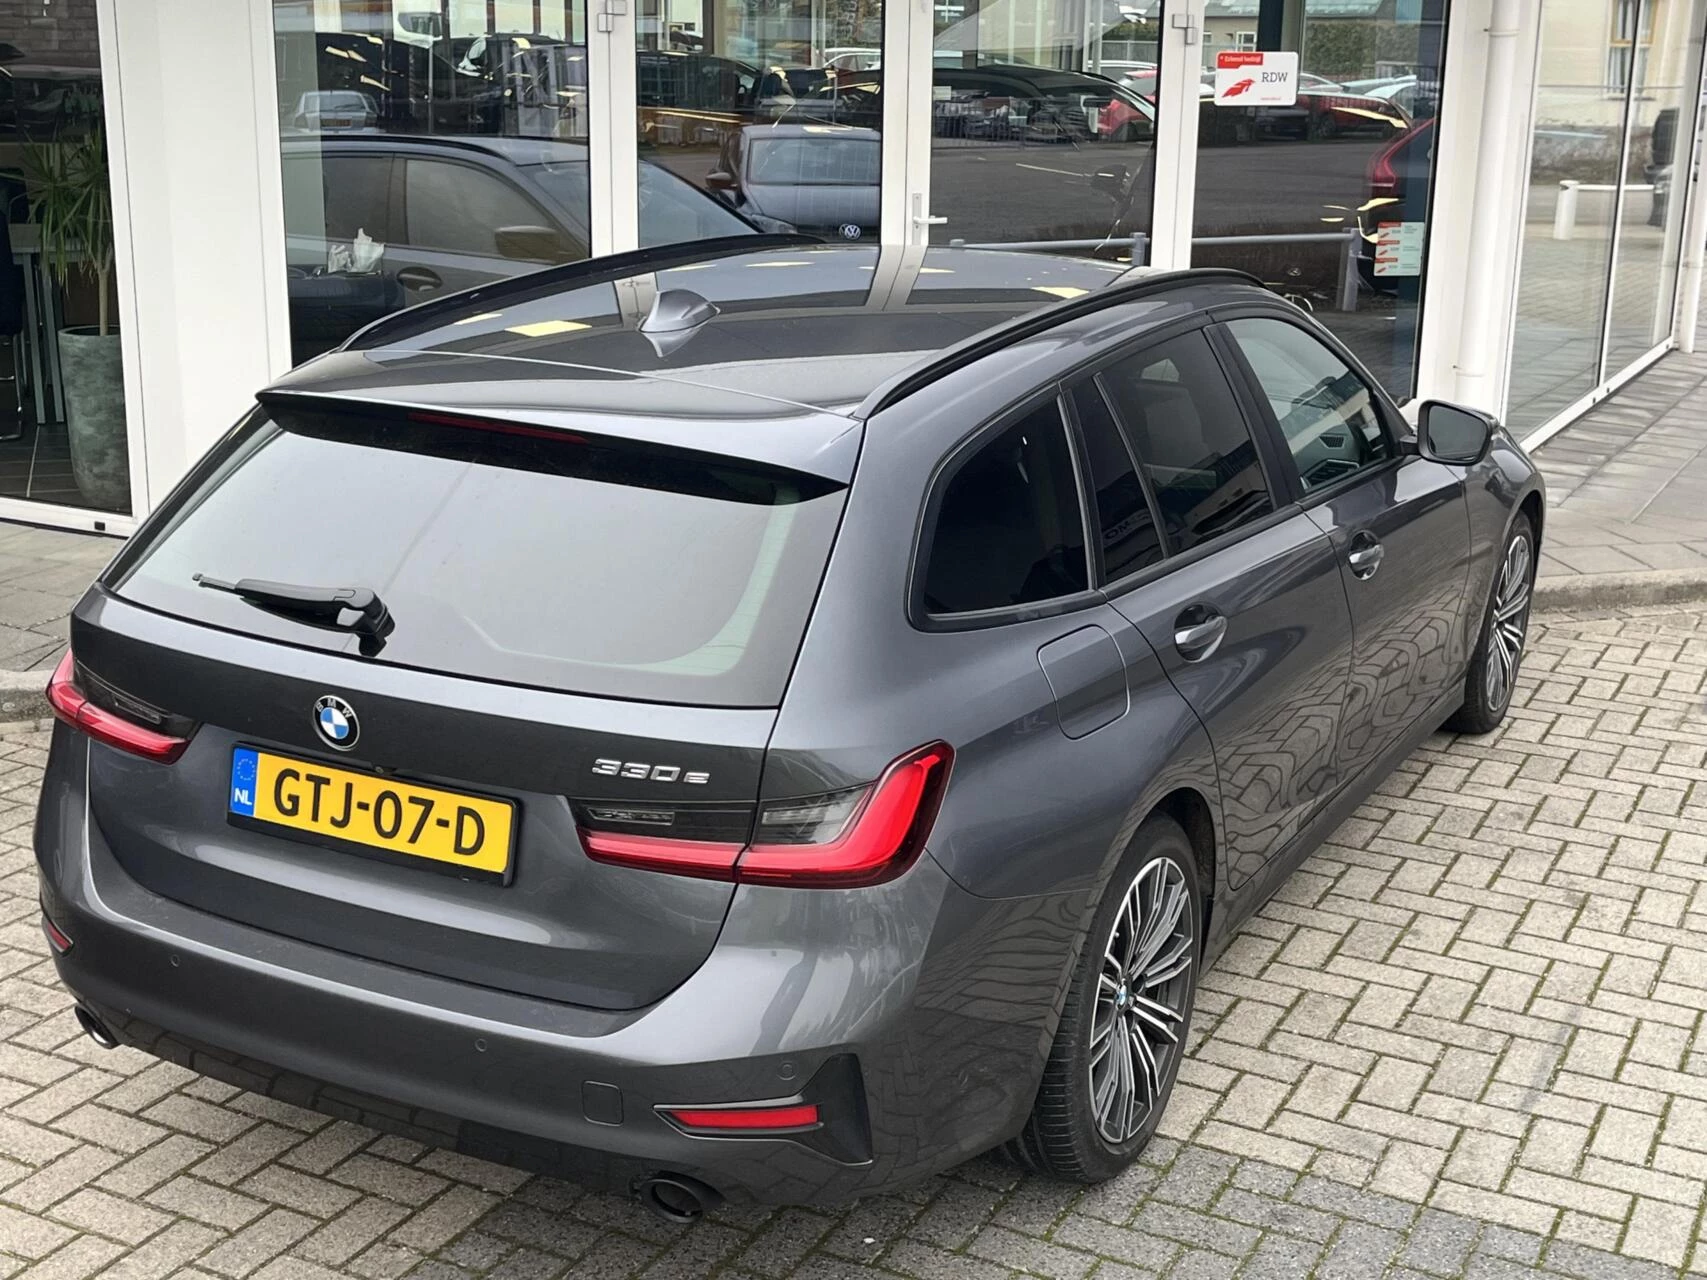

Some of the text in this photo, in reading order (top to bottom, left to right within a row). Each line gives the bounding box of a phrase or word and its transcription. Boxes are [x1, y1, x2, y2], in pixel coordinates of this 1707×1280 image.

[1261, 72, 1288, 83] RDW
[315, 697, 353, 718] BMW
[591, 758, 710, 784] 330e
[234, 787, 252, 806] NL
[273, 768, 486, 856] GTJ-07-D
